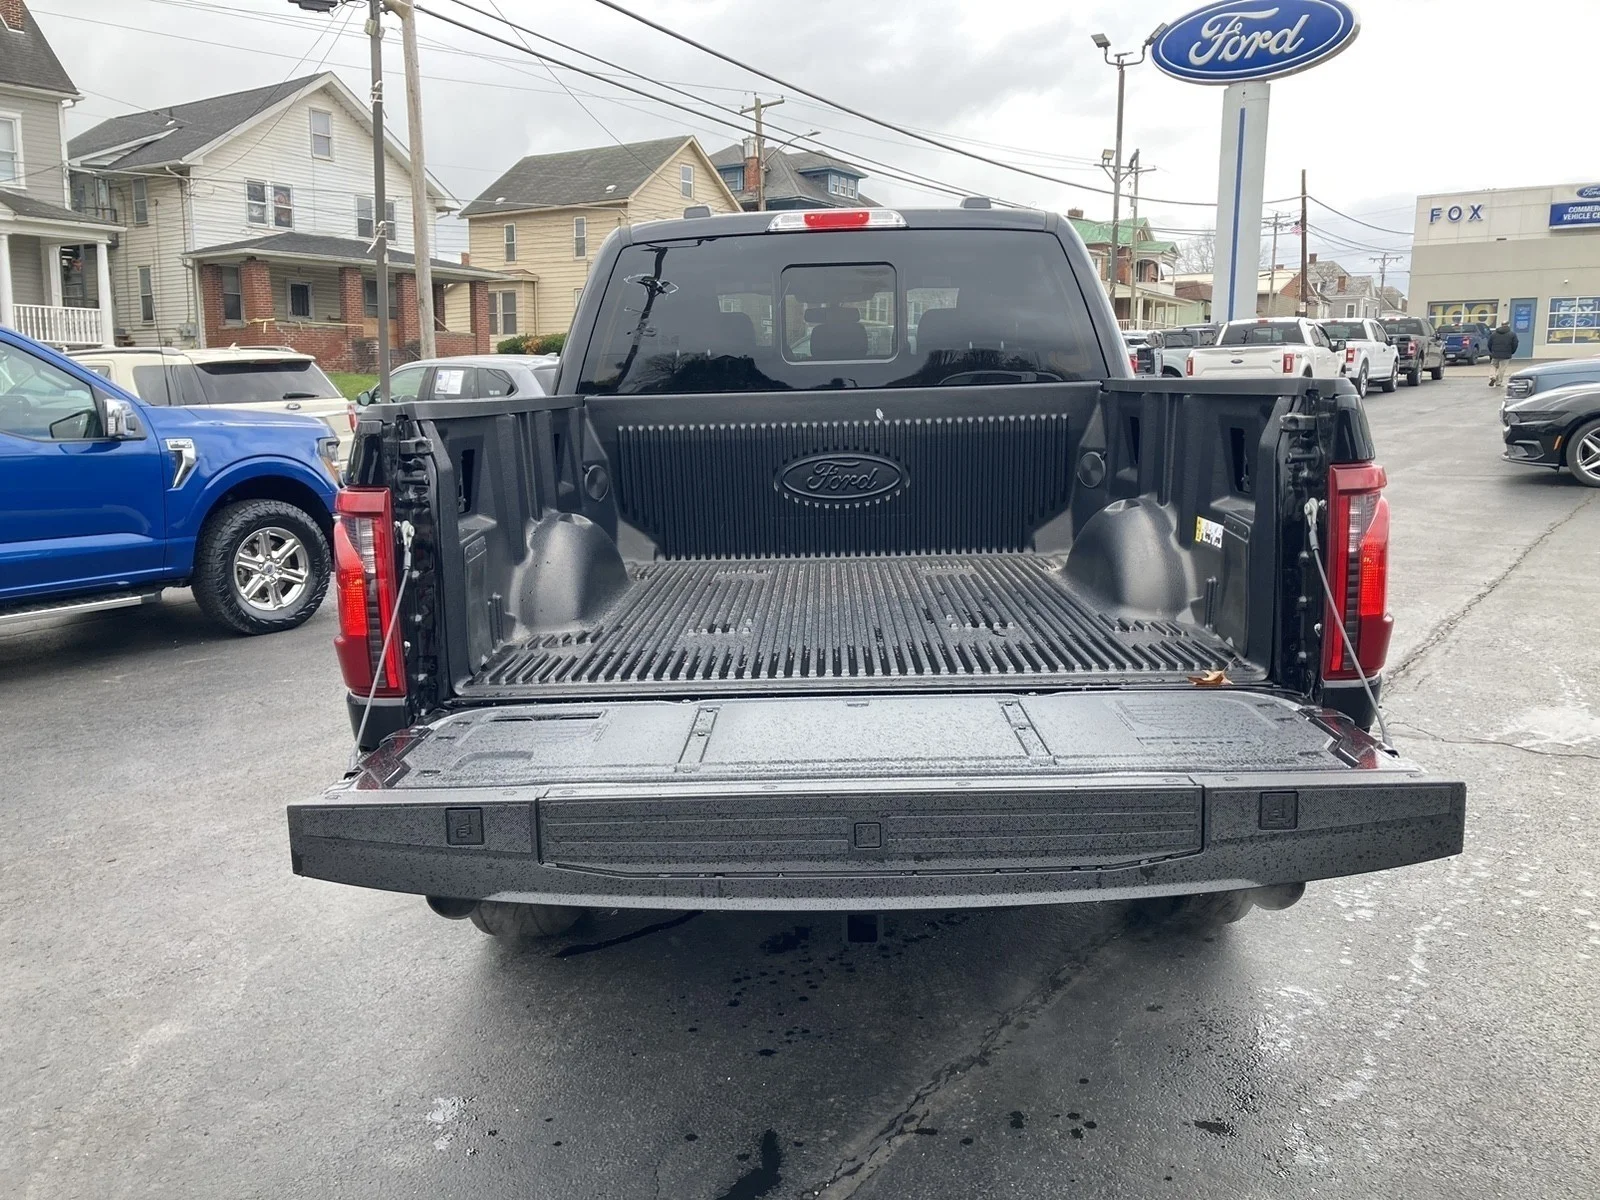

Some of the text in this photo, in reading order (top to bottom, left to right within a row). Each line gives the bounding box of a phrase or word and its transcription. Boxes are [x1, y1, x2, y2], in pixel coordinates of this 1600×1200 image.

[1188, 7, 1310, 66] Ford
[1429, 204, 1484, 224] FOX
[1563, 212, 1591, 220] VEHICLE
[1431, 303, 1496, 329] 100
[1559, 305, 1594, 317] FOX
[807, 460, 878, 490] Ford
